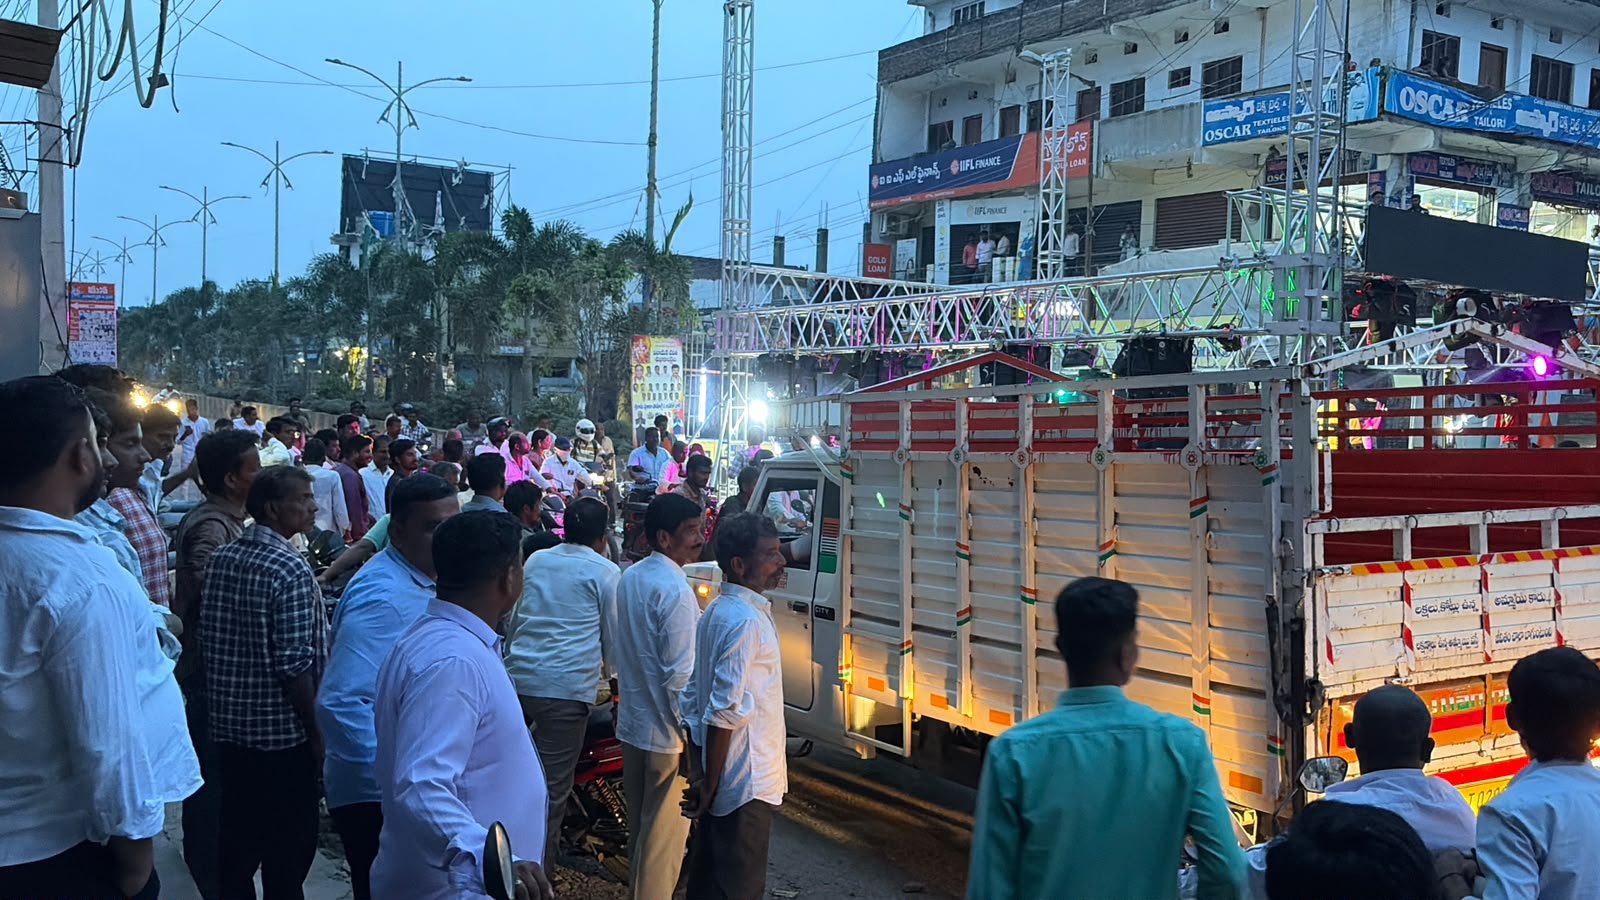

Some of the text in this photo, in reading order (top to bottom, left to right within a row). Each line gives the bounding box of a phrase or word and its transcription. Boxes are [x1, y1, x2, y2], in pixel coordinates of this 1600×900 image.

[1204, 124, 1252, 142] OSCAR
[960, 155, 1001, 172] IIFL FINANCE
[1069, 158, 1087, 168] LOAN
[1266, 172, 1299, 182] OSCR
[867, 255, 887, 264] GOLD
[867, 264, 887, 273] LOAN
